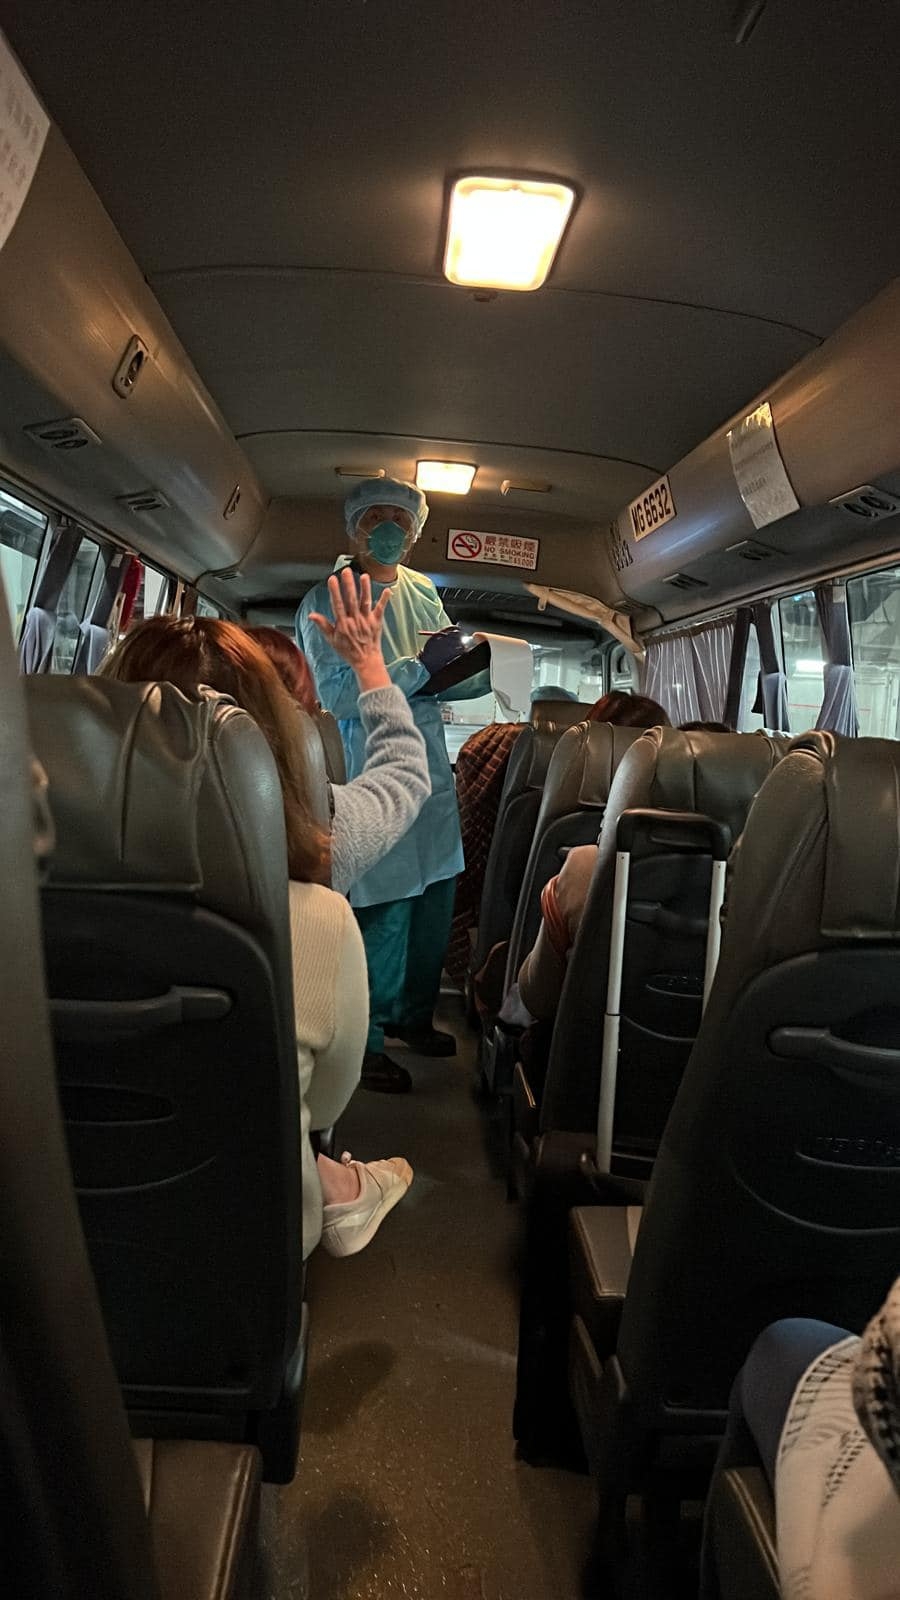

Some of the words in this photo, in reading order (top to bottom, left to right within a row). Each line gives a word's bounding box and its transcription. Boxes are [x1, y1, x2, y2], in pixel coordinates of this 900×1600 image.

[643, 484, 671, 528] 6632
[484, 545, 495, 554] NO
[499, 547, 535, 560] SMOKING
